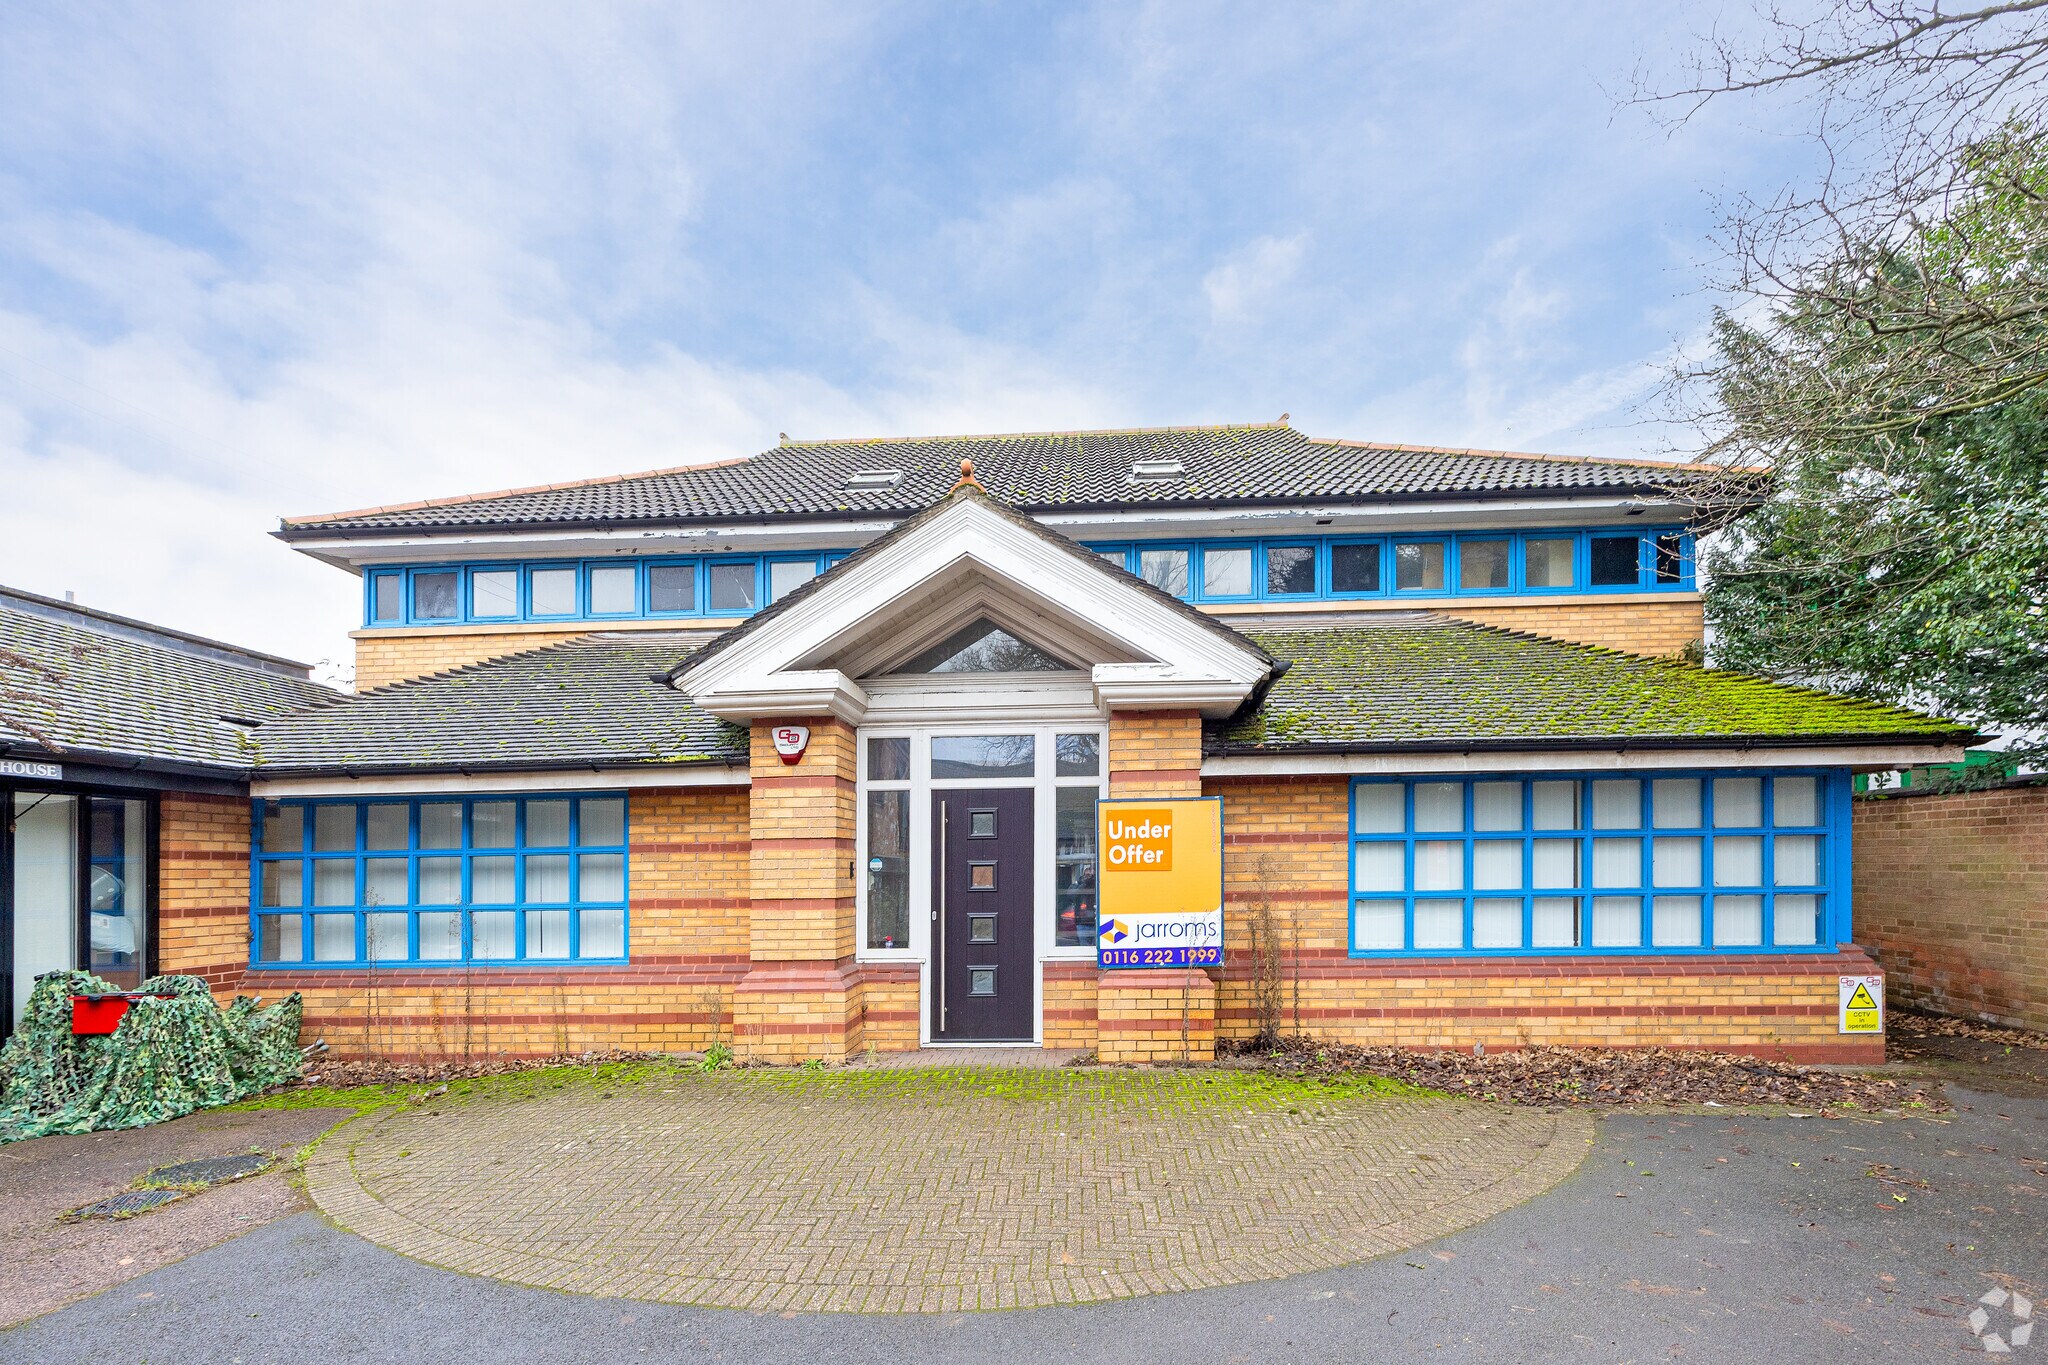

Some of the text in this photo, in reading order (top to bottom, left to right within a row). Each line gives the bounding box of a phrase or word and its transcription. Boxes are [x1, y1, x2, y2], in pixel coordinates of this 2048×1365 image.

[0, 761, 58, 777] HOUSE
[1108, 819, 1172, 840] Under
[1108, 844, 1164, 865] Offer
[1134, 920, 1217, 942] jarroms
[1103, 949, 1217, 964] 0116 222 1999
